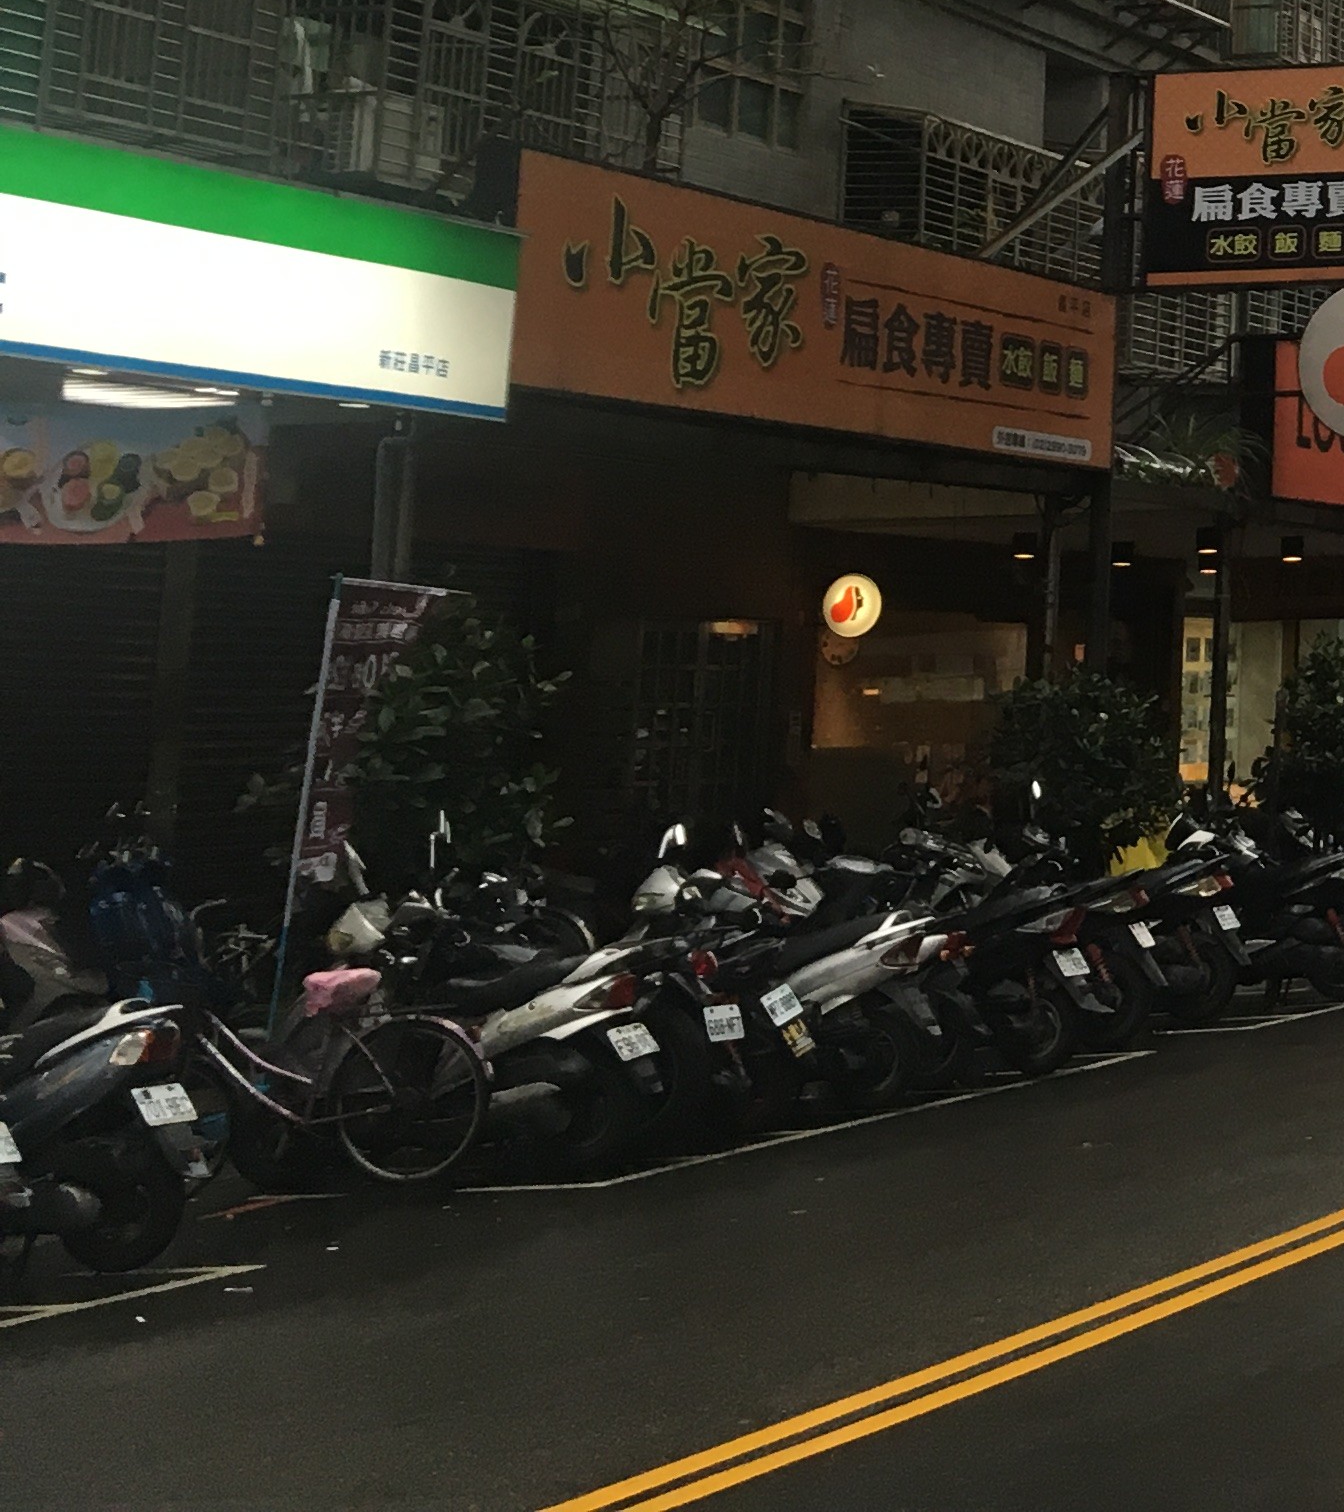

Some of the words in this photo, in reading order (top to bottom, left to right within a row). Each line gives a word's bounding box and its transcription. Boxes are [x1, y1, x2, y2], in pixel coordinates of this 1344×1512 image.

[563, 192, 809, 389] 小當家
[1210, 233, 1258, 256] 水餃
[1274, 231, 1299, 254] 飯
[838, 293, 995, 392] 扁食專賣
